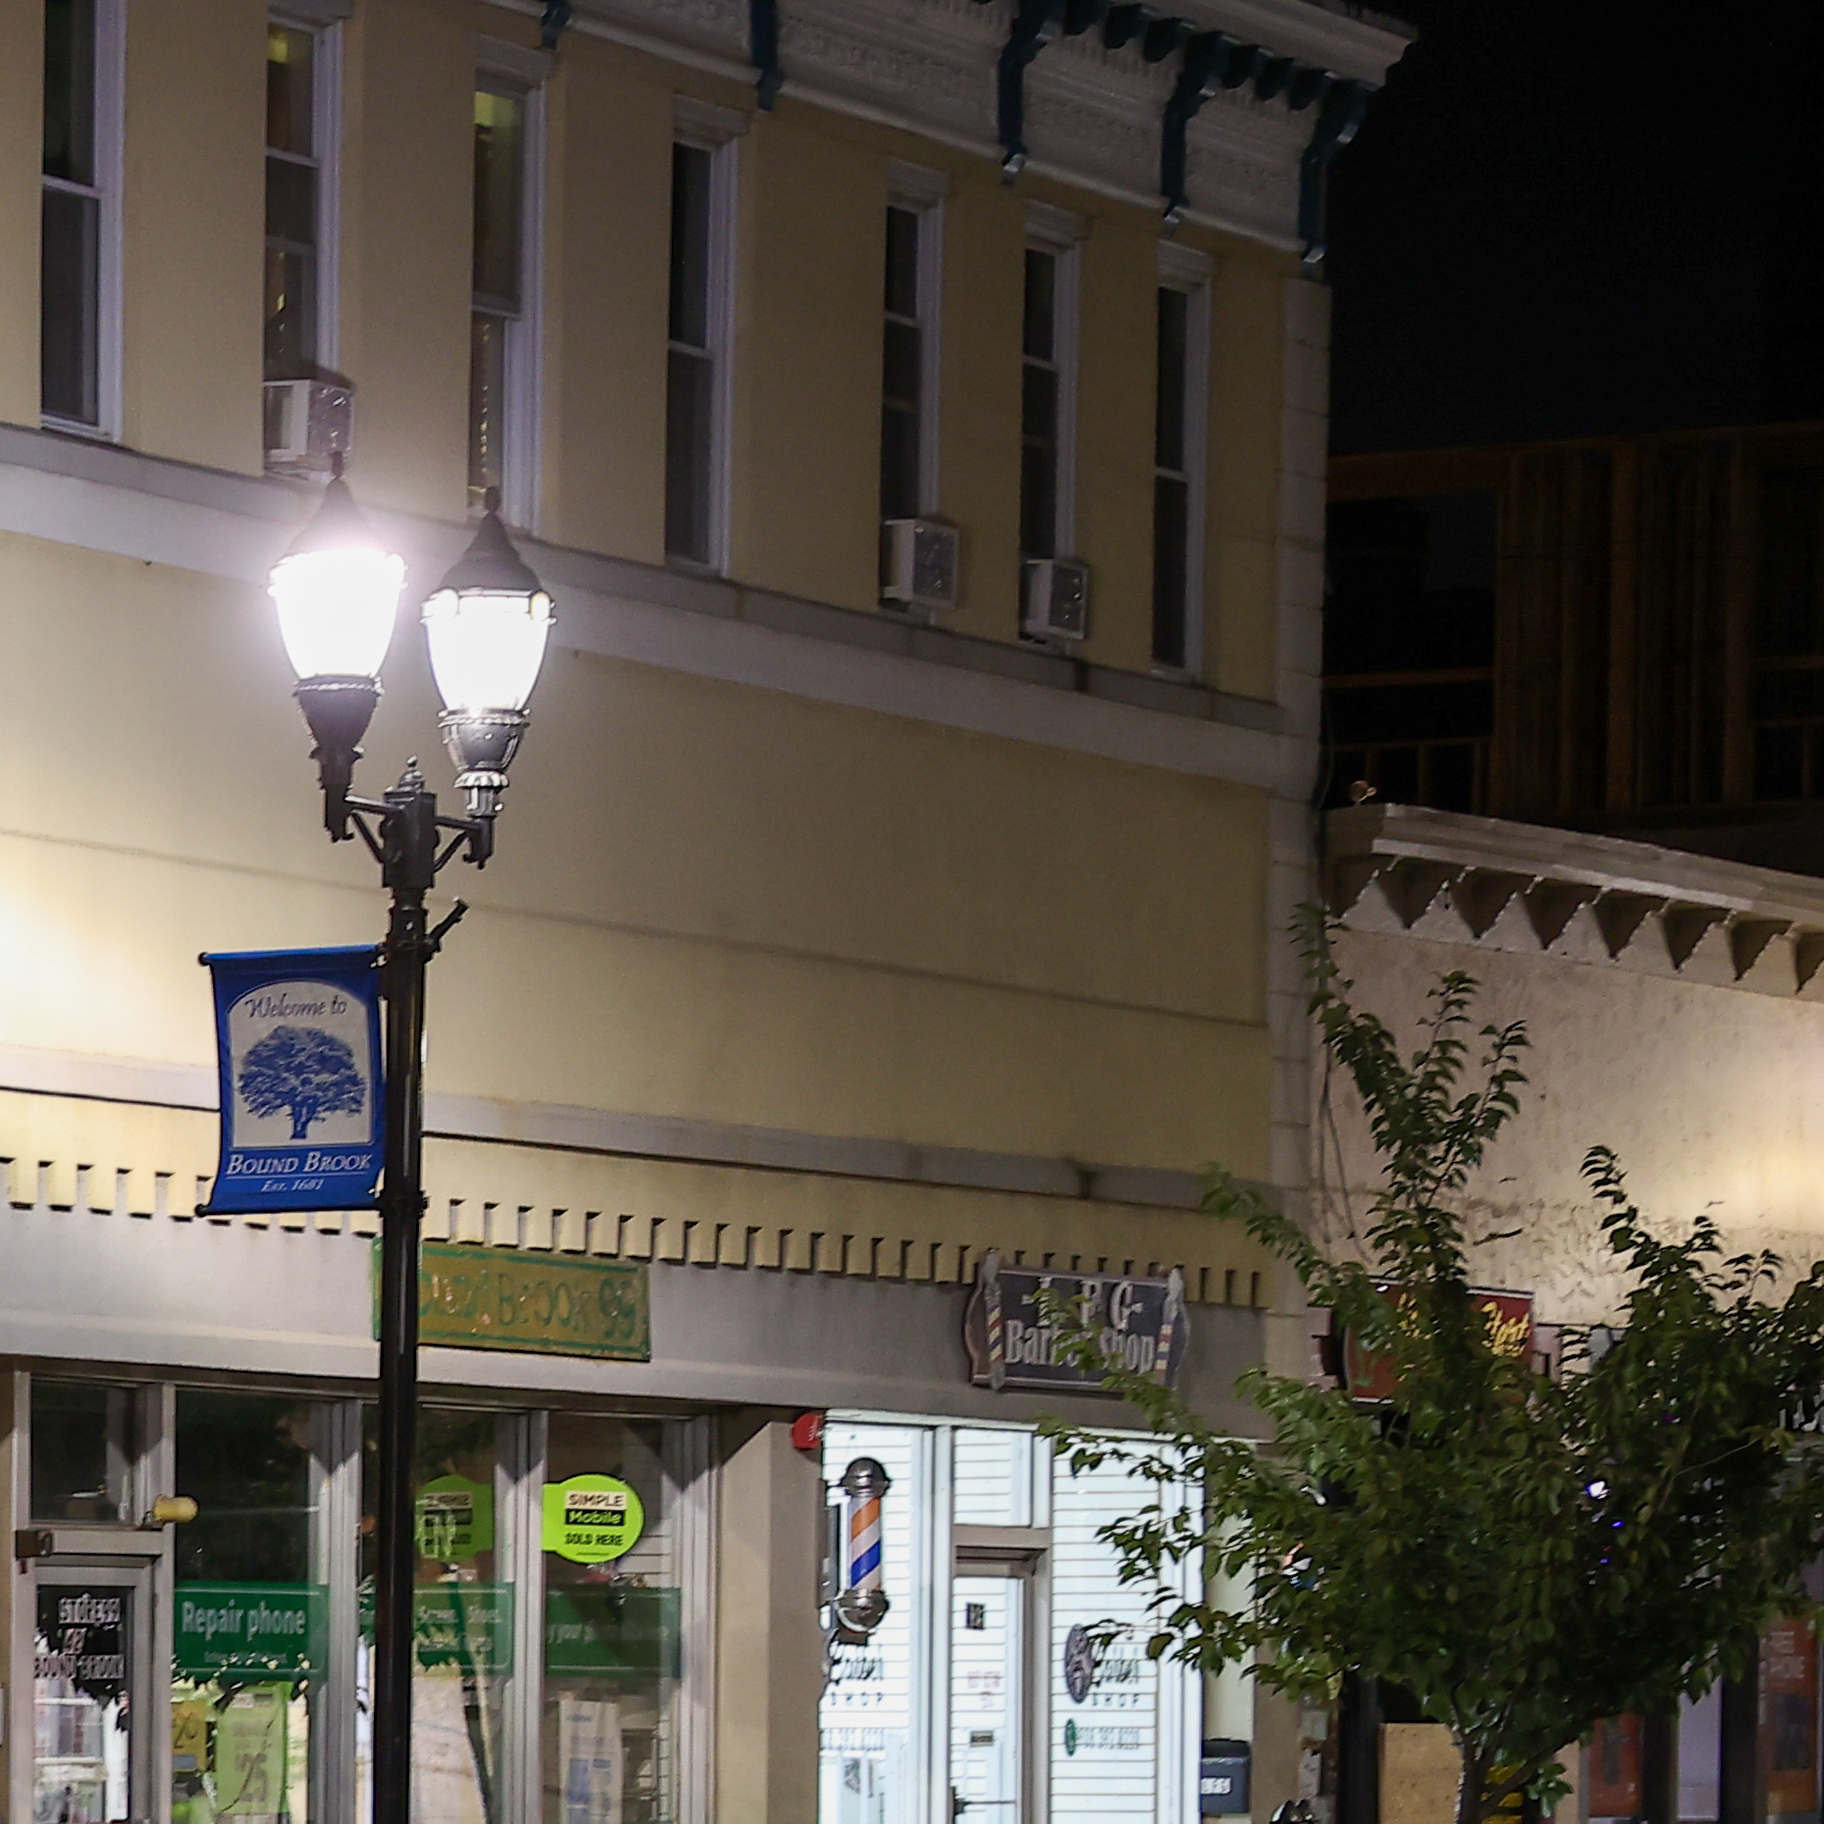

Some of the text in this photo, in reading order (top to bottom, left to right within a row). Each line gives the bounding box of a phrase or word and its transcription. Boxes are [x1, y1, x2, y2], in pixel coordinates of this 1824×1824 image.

[245, 993, 348, 1018] Welcome to
[291, 1178, 325, 1192] 1681
[568, 1493, 625, 1508] SIMPLE
[568, 1509, 623, 1525] Mobile
[595, 1533, 624, 1547] HERE
[181, 1598, 307, 1642] Repair phone
